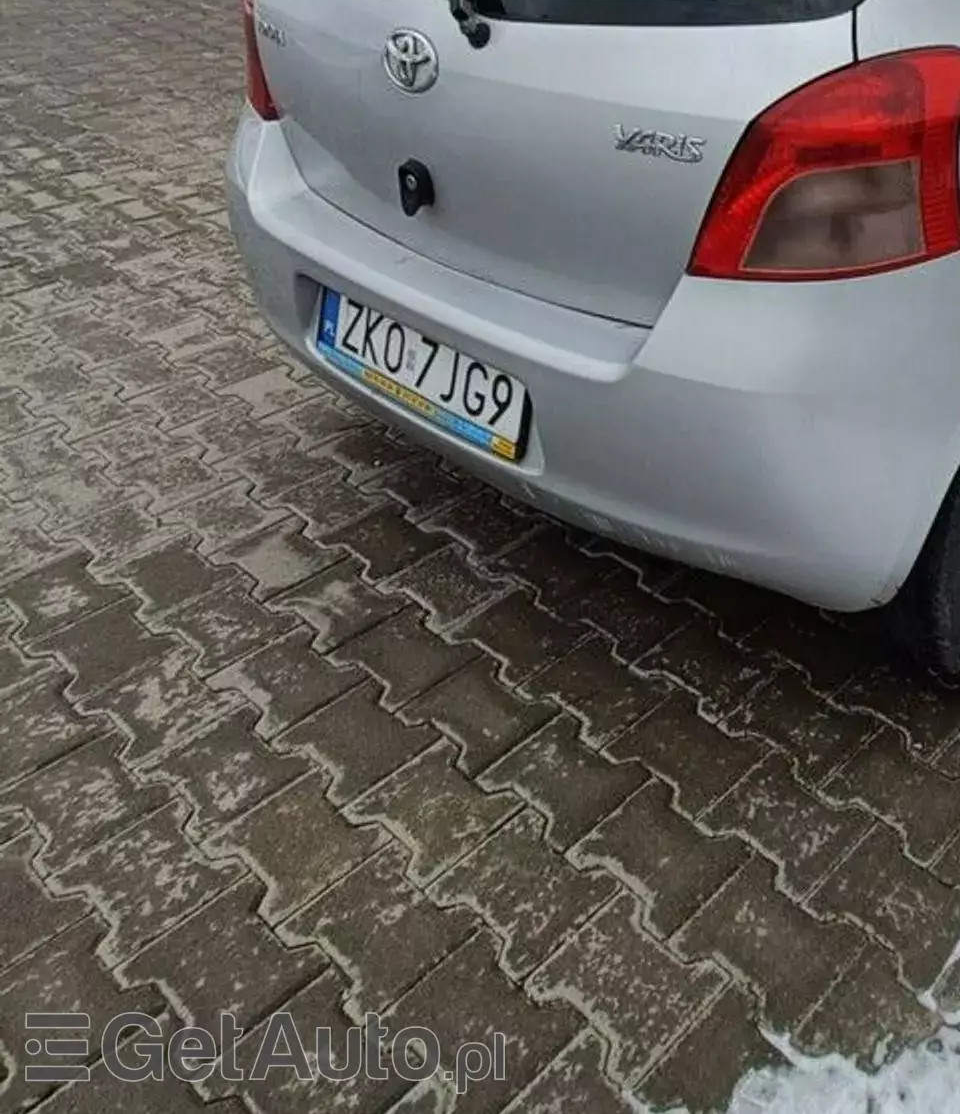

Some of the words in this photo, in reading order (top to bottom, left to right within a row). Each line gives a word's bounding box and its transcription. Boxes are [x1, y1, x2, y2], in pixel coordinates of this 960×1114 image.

[613, 123, 707, 164] YARIS
[341, 298, 406, 374] ZKO
[414, 336, 514, 427] 7JG9
